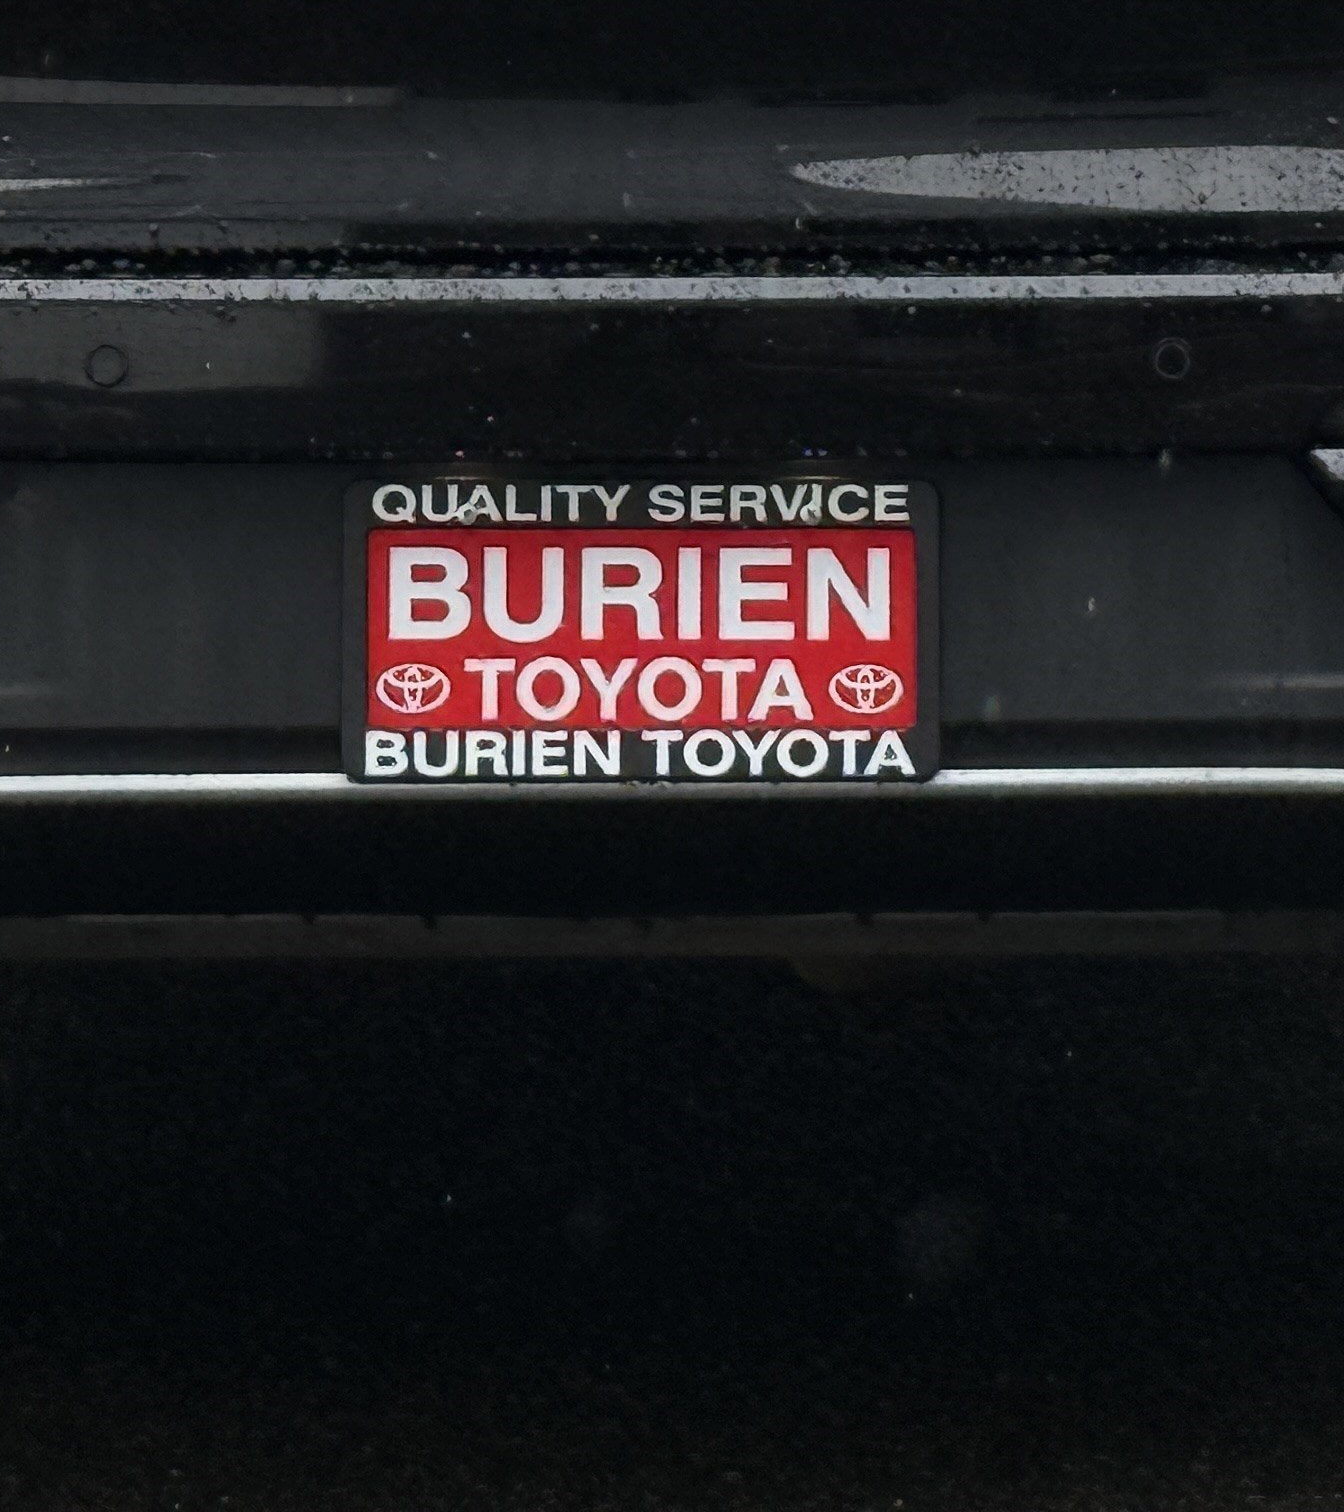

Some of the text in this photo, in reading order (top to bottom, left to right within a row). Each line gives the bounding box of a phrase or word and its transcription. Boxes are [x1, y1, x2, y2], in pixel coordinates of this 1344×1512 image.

[371, 483, 910, 525] QUALITY SERVICE
[388, 545, 891, 643] BURIEN
[463, 655, 815, 723] TOYOTA
[364, 728, 916, 778] BURIEN TOYOTA
